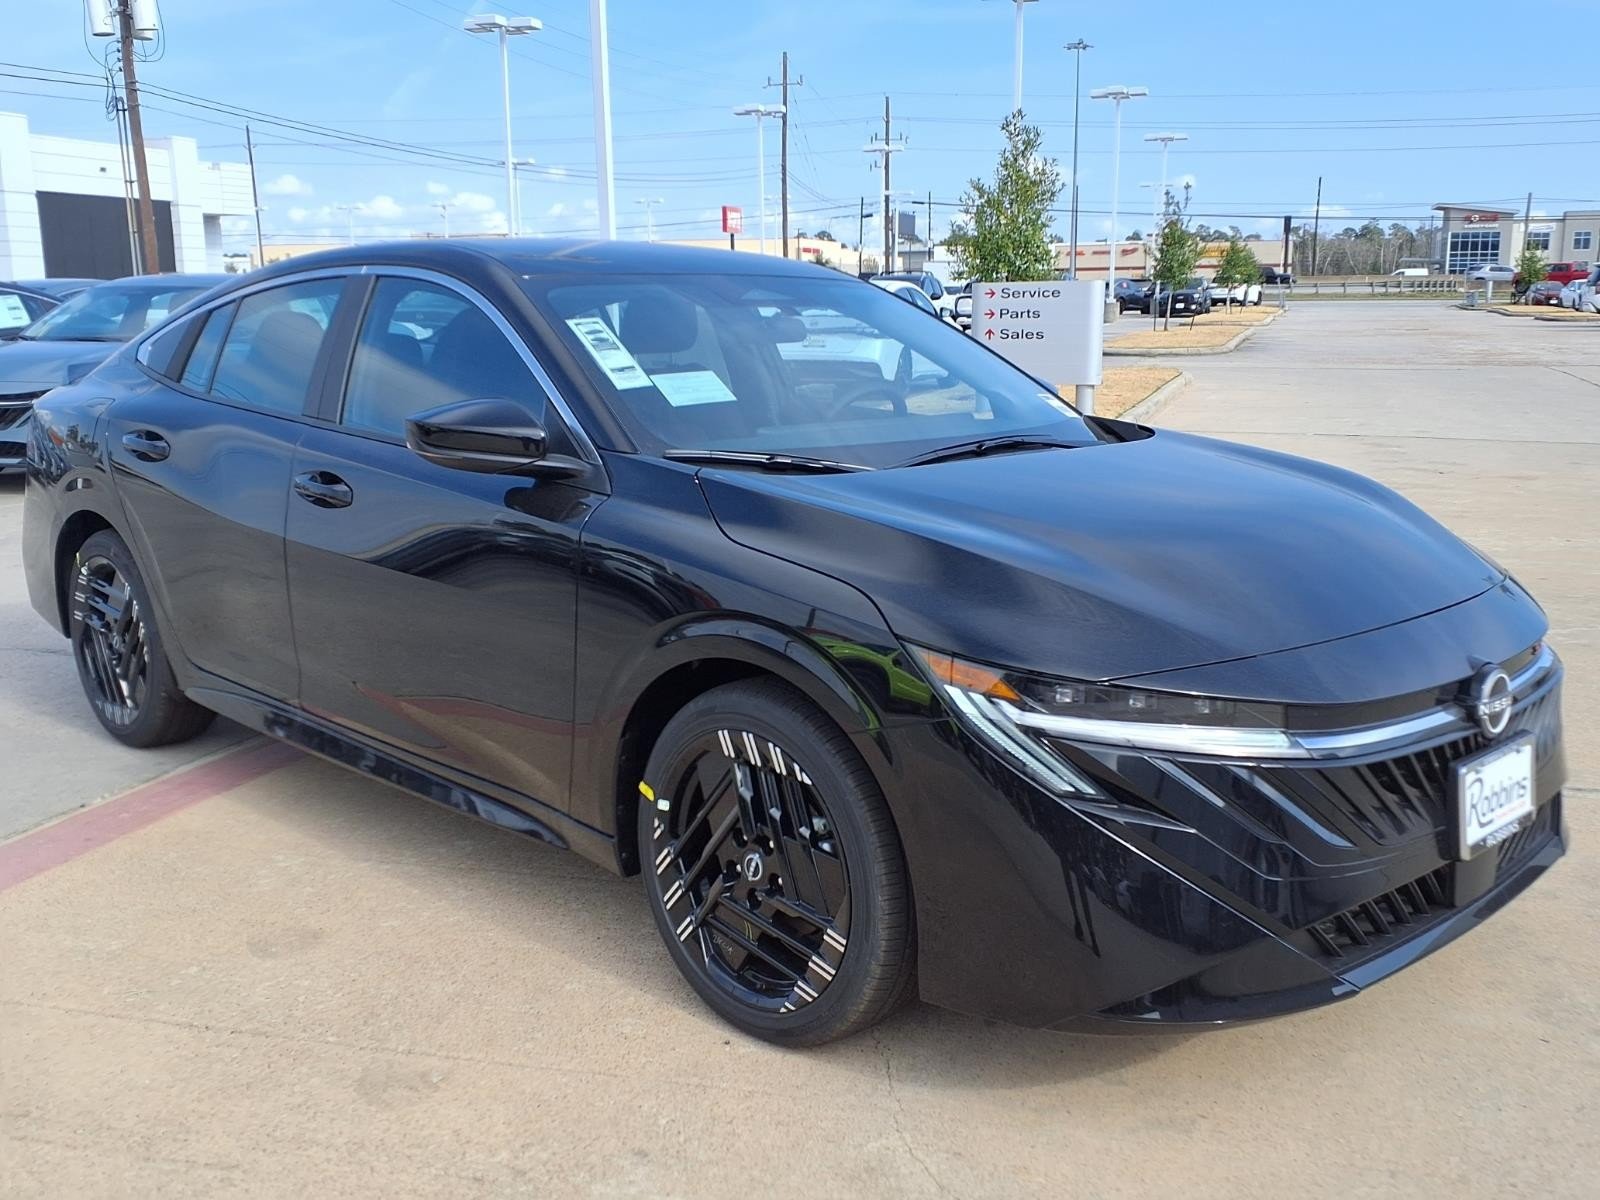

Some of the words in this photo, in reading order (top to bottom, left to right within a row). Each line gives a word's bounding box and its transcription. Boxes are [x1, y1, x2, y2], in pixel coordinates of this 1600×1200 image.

[1000, 287, 1061, 299] Service
[999, 308, 1041, 319] Parts
[999, 328, 1045, 340] Sales
[1466, 776, 1528, 828] Robbins
